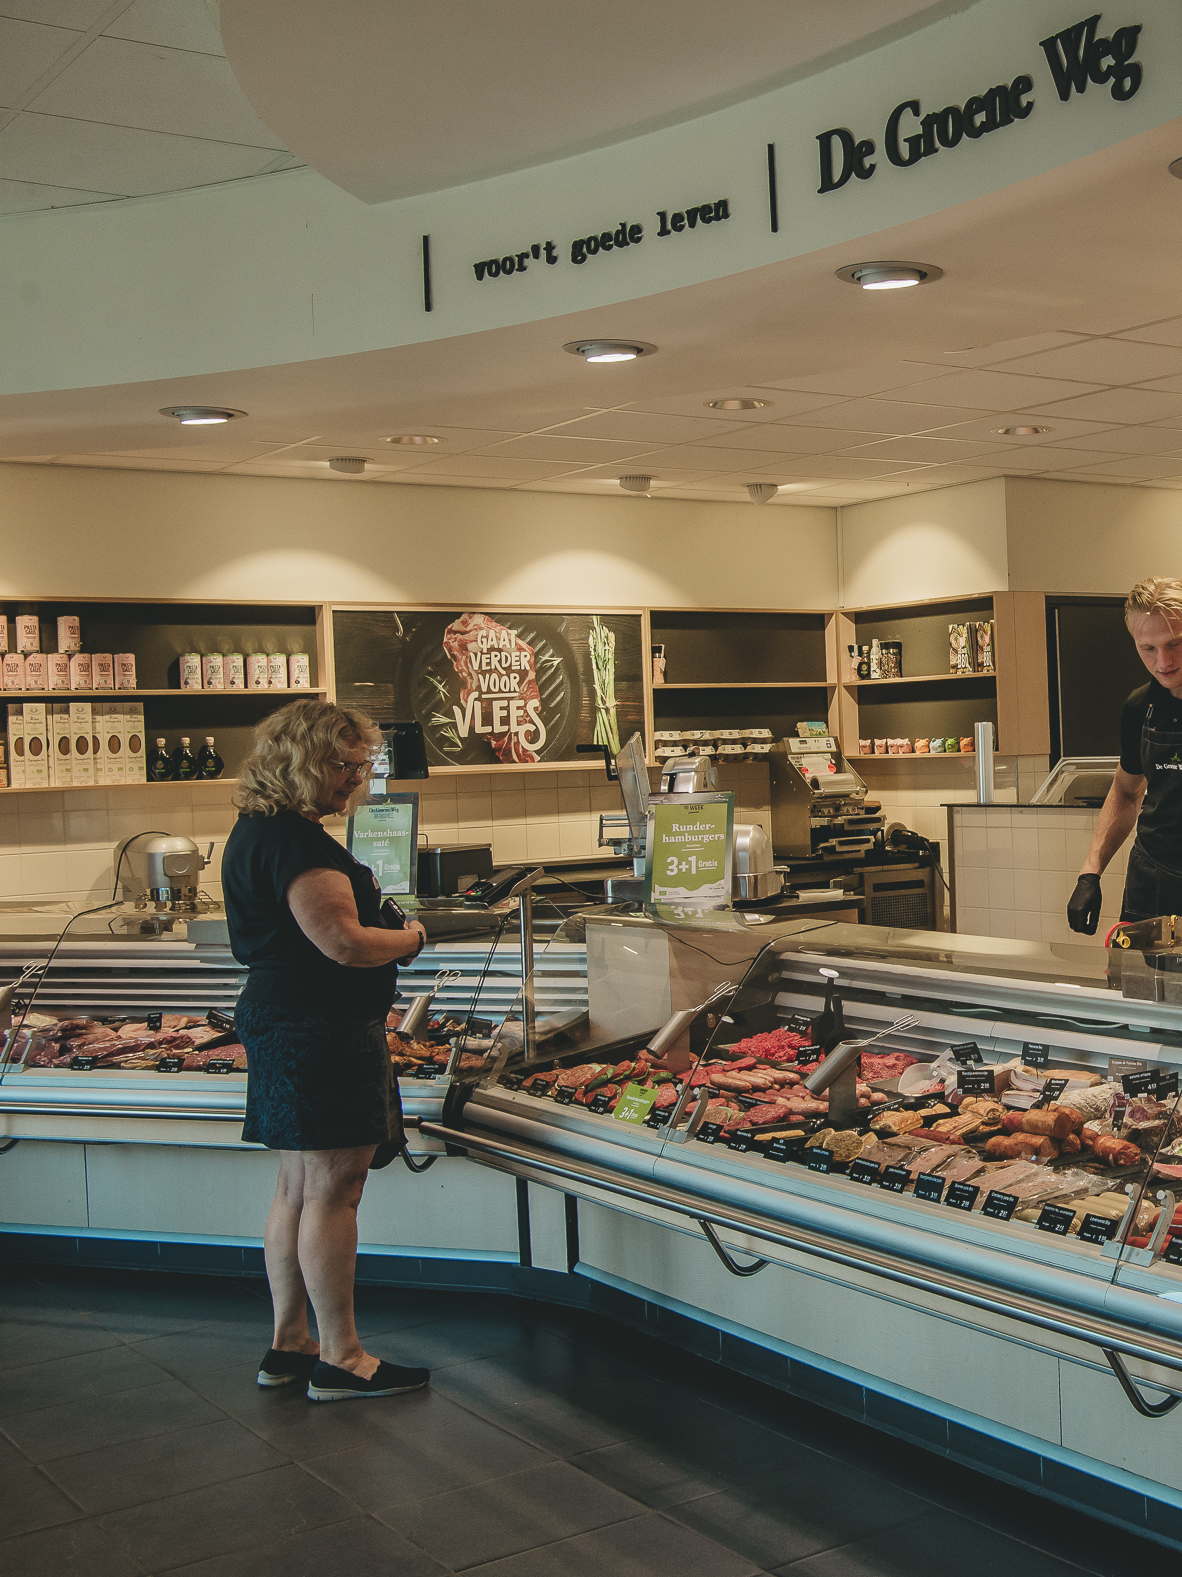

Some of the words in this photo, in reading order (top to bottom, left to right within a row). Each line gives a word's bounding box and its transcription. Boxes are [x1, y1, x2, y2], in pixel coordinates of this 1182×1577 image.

[816, 127, 876, 194] De
[885, 74, 1034, 167] Groene
[1039, 14, 1142, 101] Weg
[473, 241, 558, 281] voor't
[571, 222, 643, 264] goede
[656, 198, 730, 237] leven
[478, 630, 517, 653] GAAT
[470, 652, 530, 674] VERDER
[478, 673, 519, 692] VOOR
[453, 691, 546, 751] VLEES
[353, 829, 409, 838] Varkenshaas-
[672, 822, 715, 832] Runder-
[372, 838, 389, 847] saté
[662, 833, 725, 843] hamburgers
[666, 855, 697, 876] 3+1
[619, 1107, 634, 1119] 3+1
